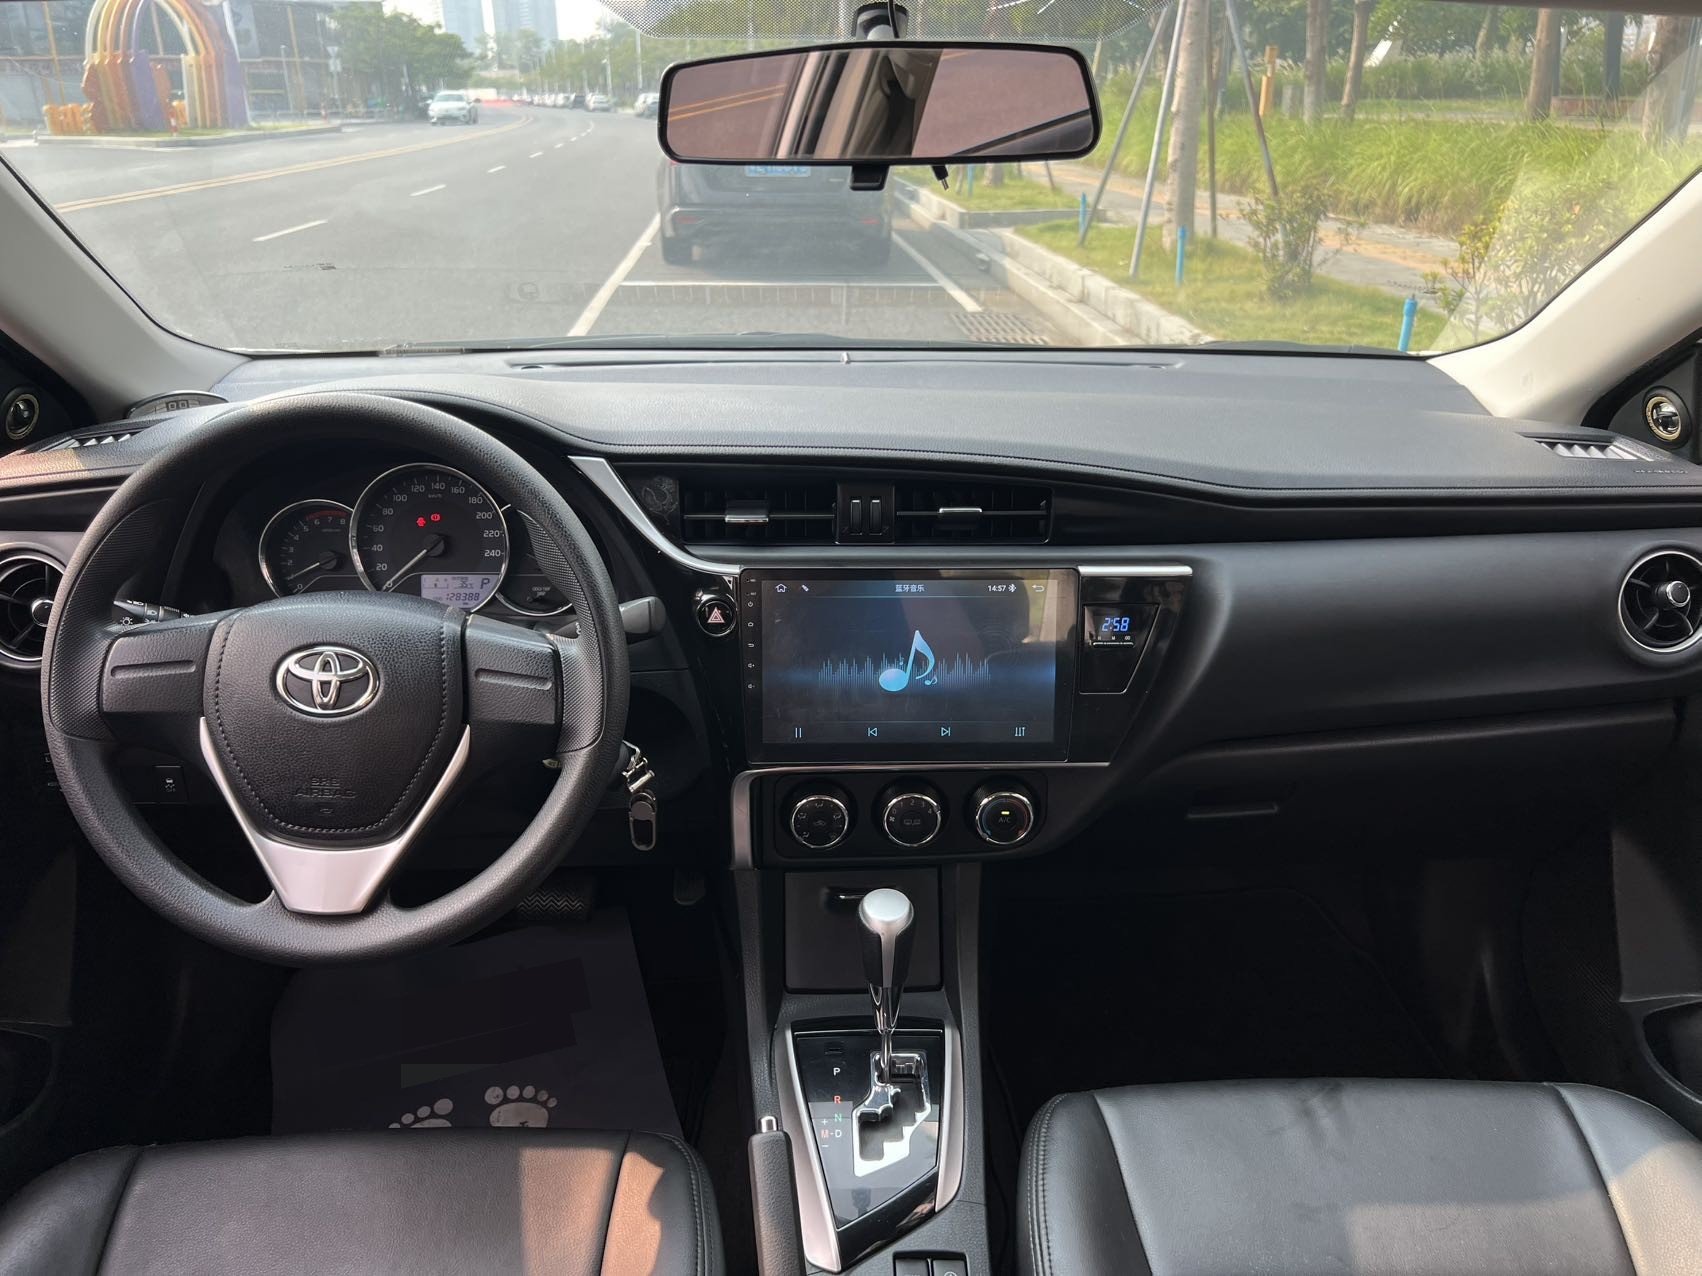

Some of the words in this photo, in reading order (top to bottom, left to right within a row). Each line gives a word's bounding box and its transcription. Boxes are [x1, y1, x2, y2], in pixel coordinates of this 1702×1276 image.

[480, 578, 490, 589] P
[446, 592, 480, 600] 128388
[1102, 617, 1130, 631] 2:58
[833, 1067, 840, 1076] P
[834, 1095, 841, 1104] R
[834, 1113, 842, 1122] N
